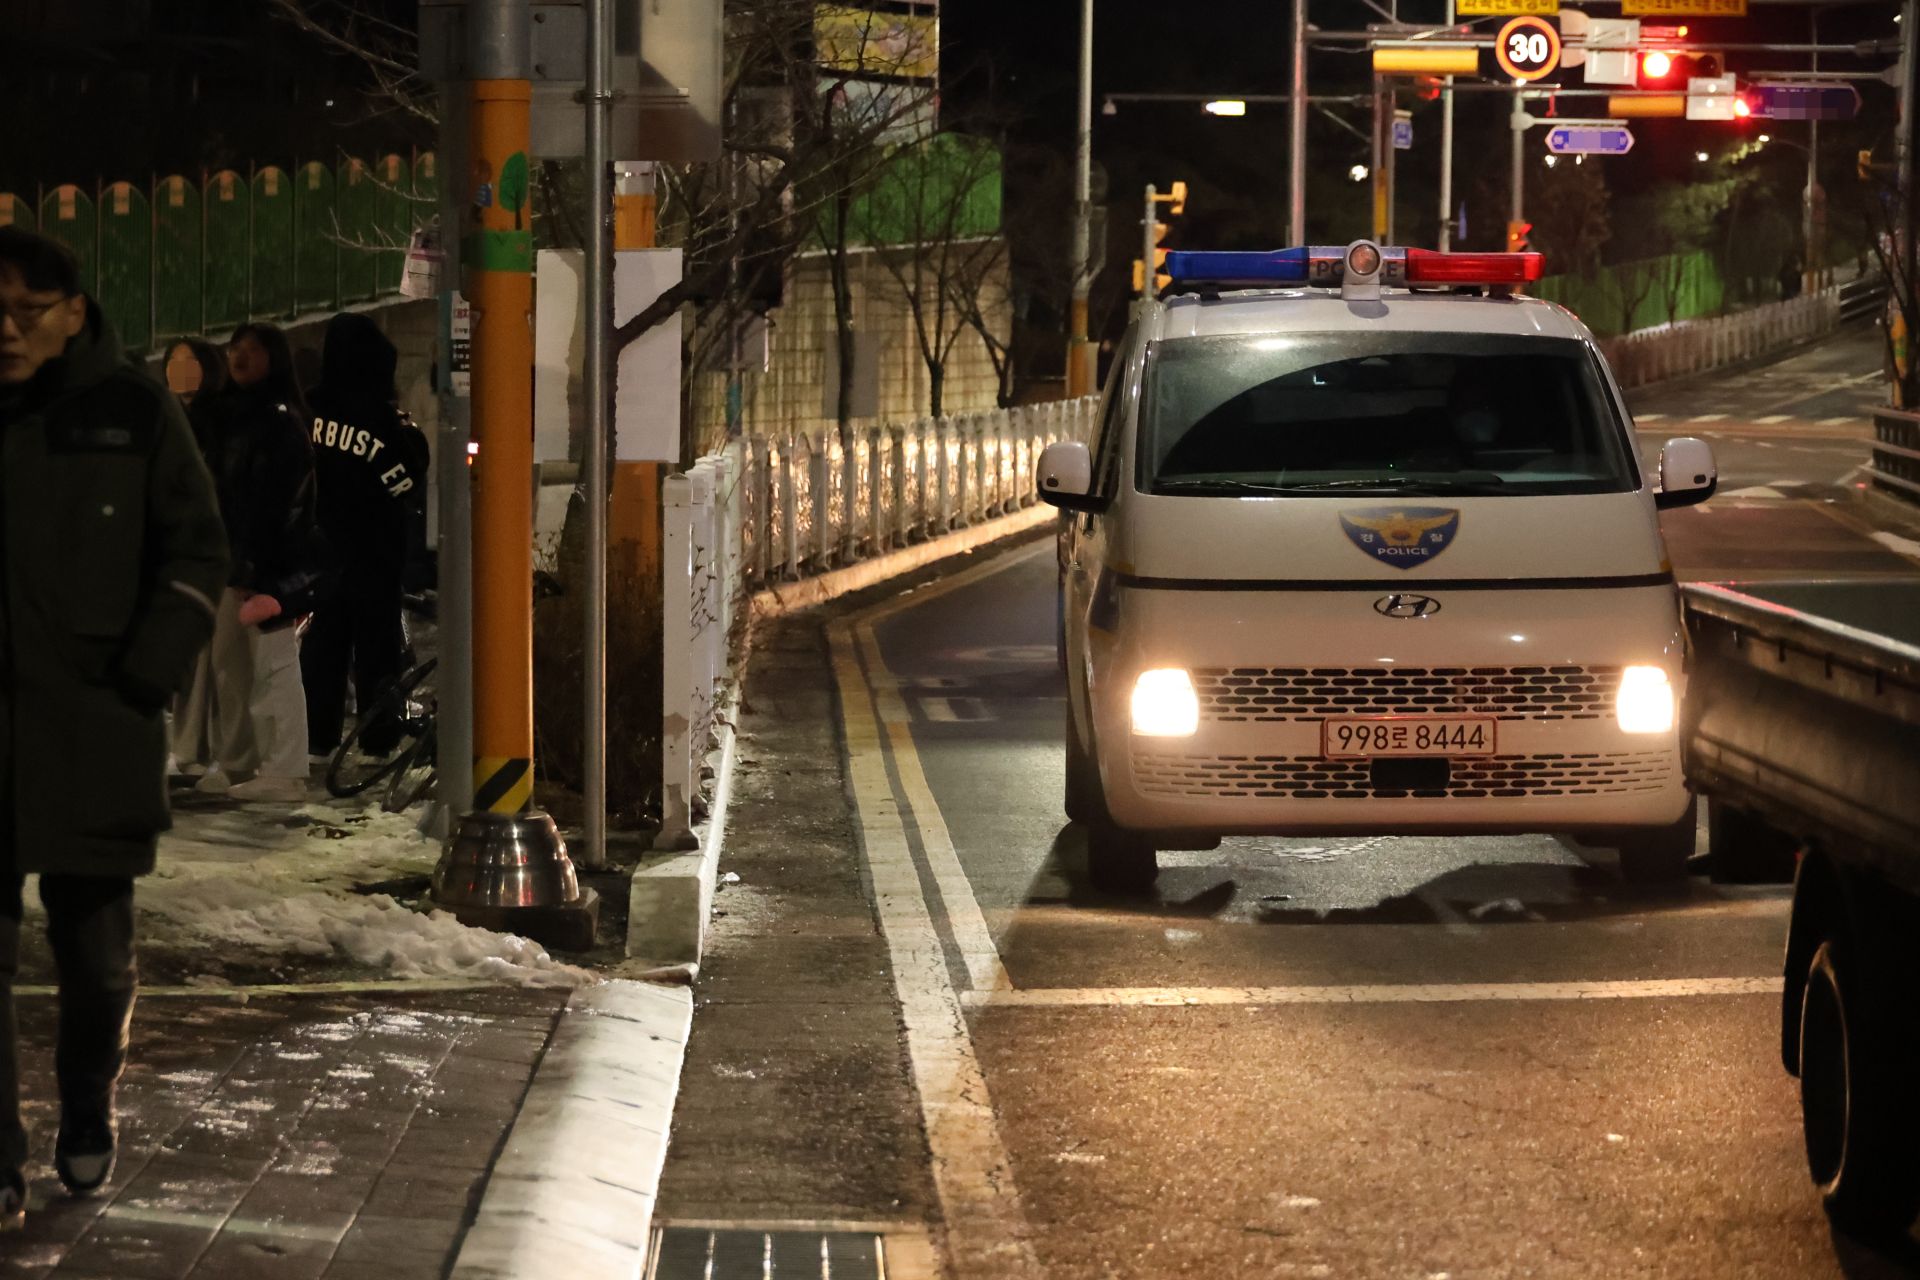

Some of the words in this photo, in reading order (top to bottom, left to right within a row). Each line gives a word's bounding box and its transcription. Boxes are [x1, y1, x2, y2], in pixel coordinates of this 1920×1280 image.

[1509, 33, 1548, 63] 30
[1377, 547, 1429, 556] POLICE
[1337, 725, 1408, 750] 998로
[1415, 724, 1485, 750] 8444
